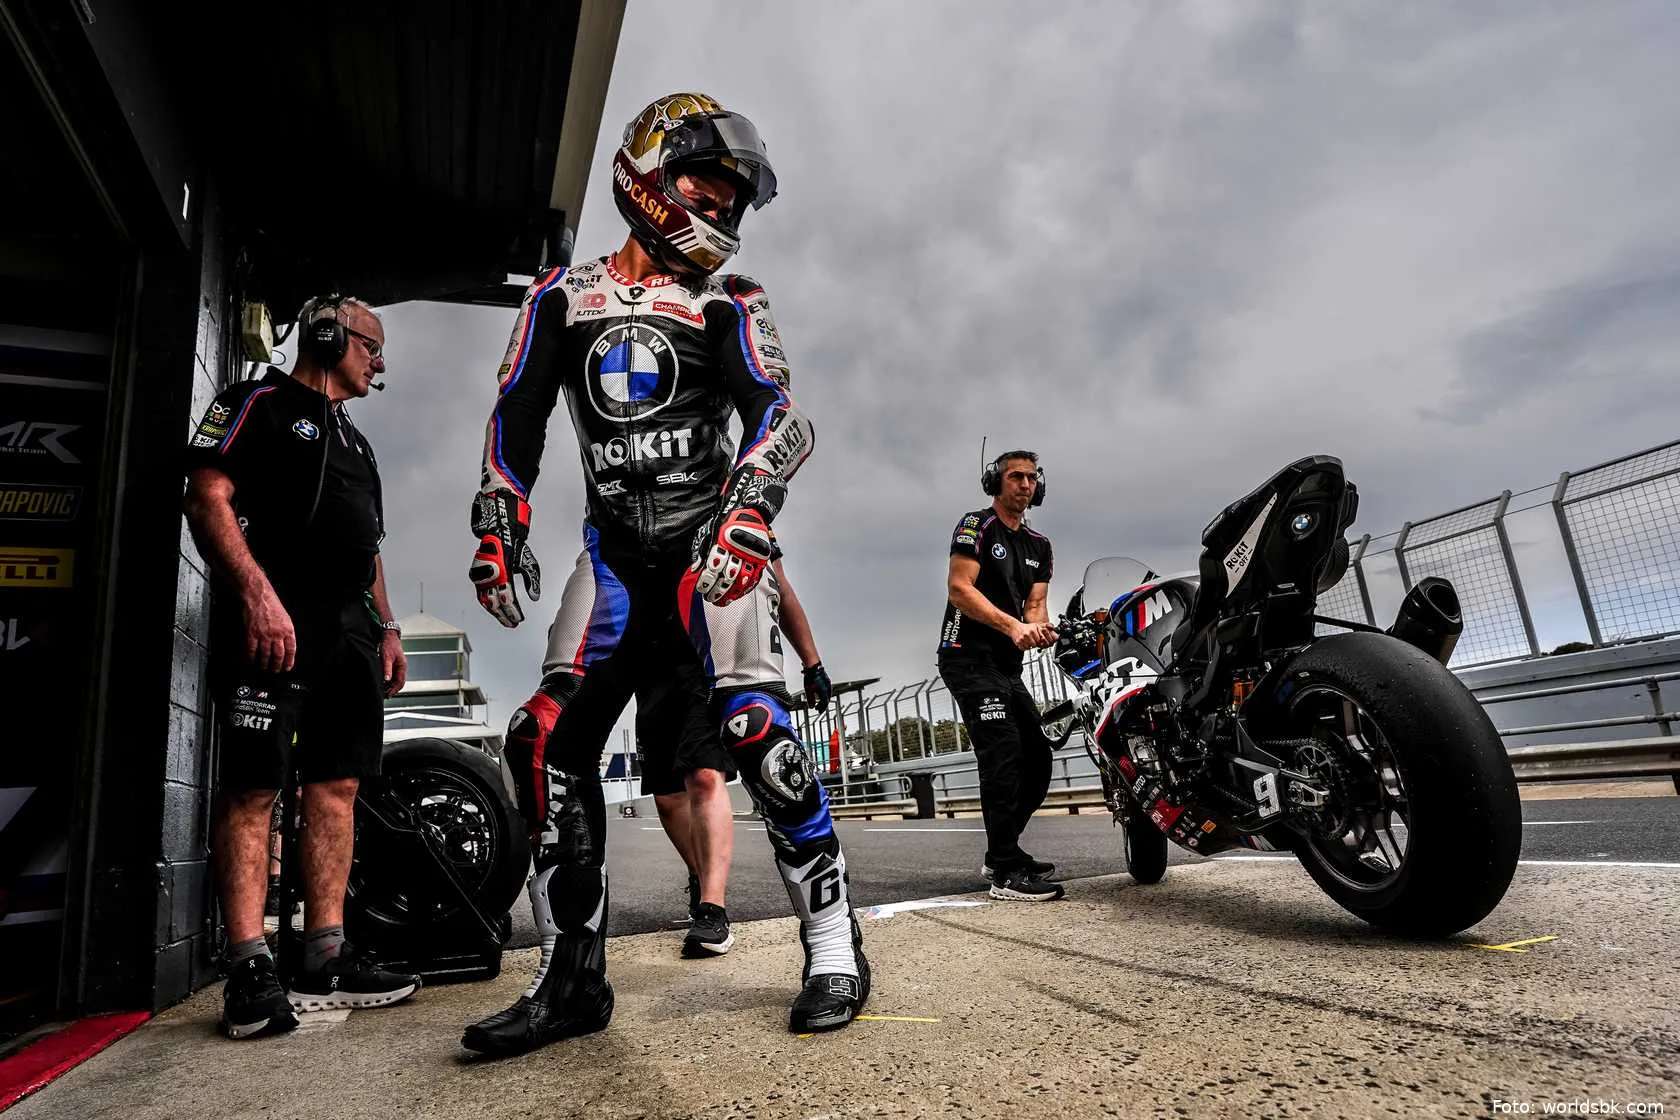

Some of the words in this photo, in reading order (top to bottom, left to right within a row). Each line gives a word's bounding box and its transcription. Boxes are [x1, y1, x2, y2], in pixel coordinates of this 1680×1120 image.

[590, 428, 692, 472] ROKiT
[763, 418, 803, 472] ROKiT
[656, 472, 699, 485] SBK
[1254, 773, 1281, 817] 9
